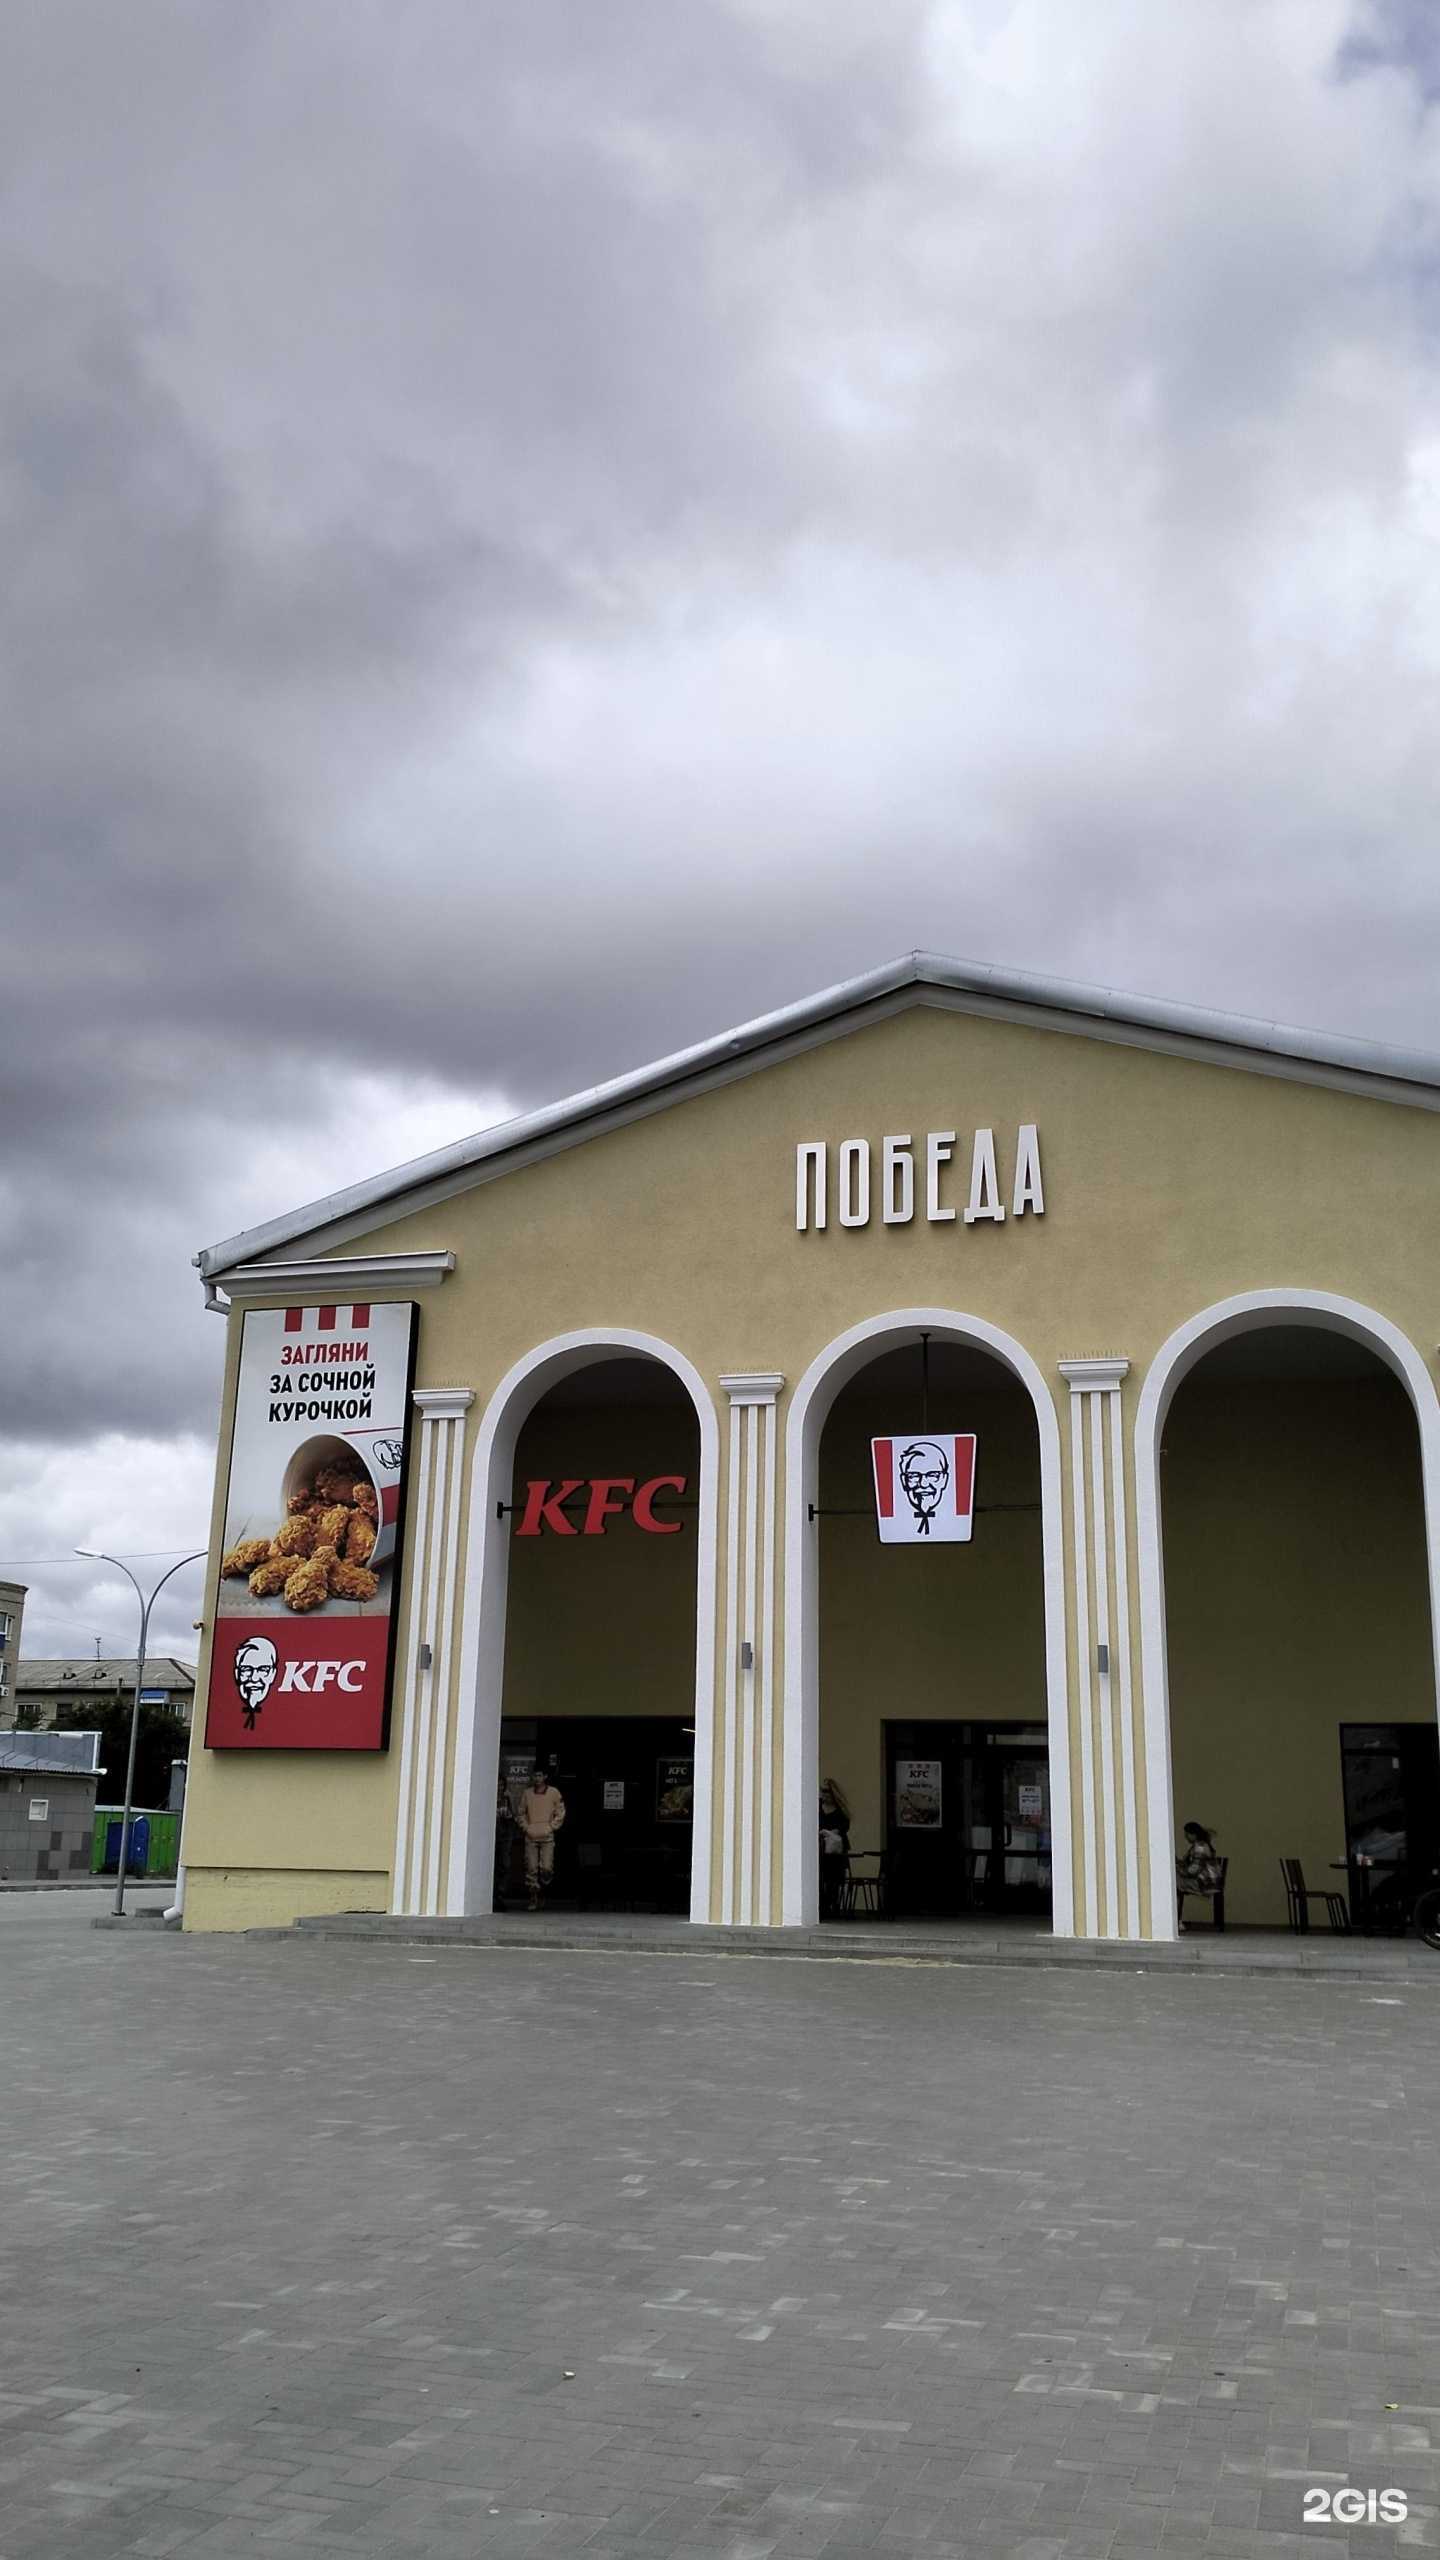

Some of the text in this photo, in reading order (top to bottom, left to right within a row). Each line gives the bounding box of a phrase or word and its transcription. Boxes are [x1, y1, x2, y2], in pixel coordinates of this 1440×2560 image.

[796, 1123, 1045, 1230] ПОБЕДА
[280, 1341, 369, 1365] ЗАГЛЯНИ
[269, 1363, 376, 1394] ЗА СОЧНОЙ
[268, 1392, 372, 1422] КУРОЧКОЙ
[514, 1475, 687, 1538] KFC
[277, 1660, 367, 1692] KFC
[668, 1766, 688, 1775] KFC
[909, 1770, 929, 1778] KFC
